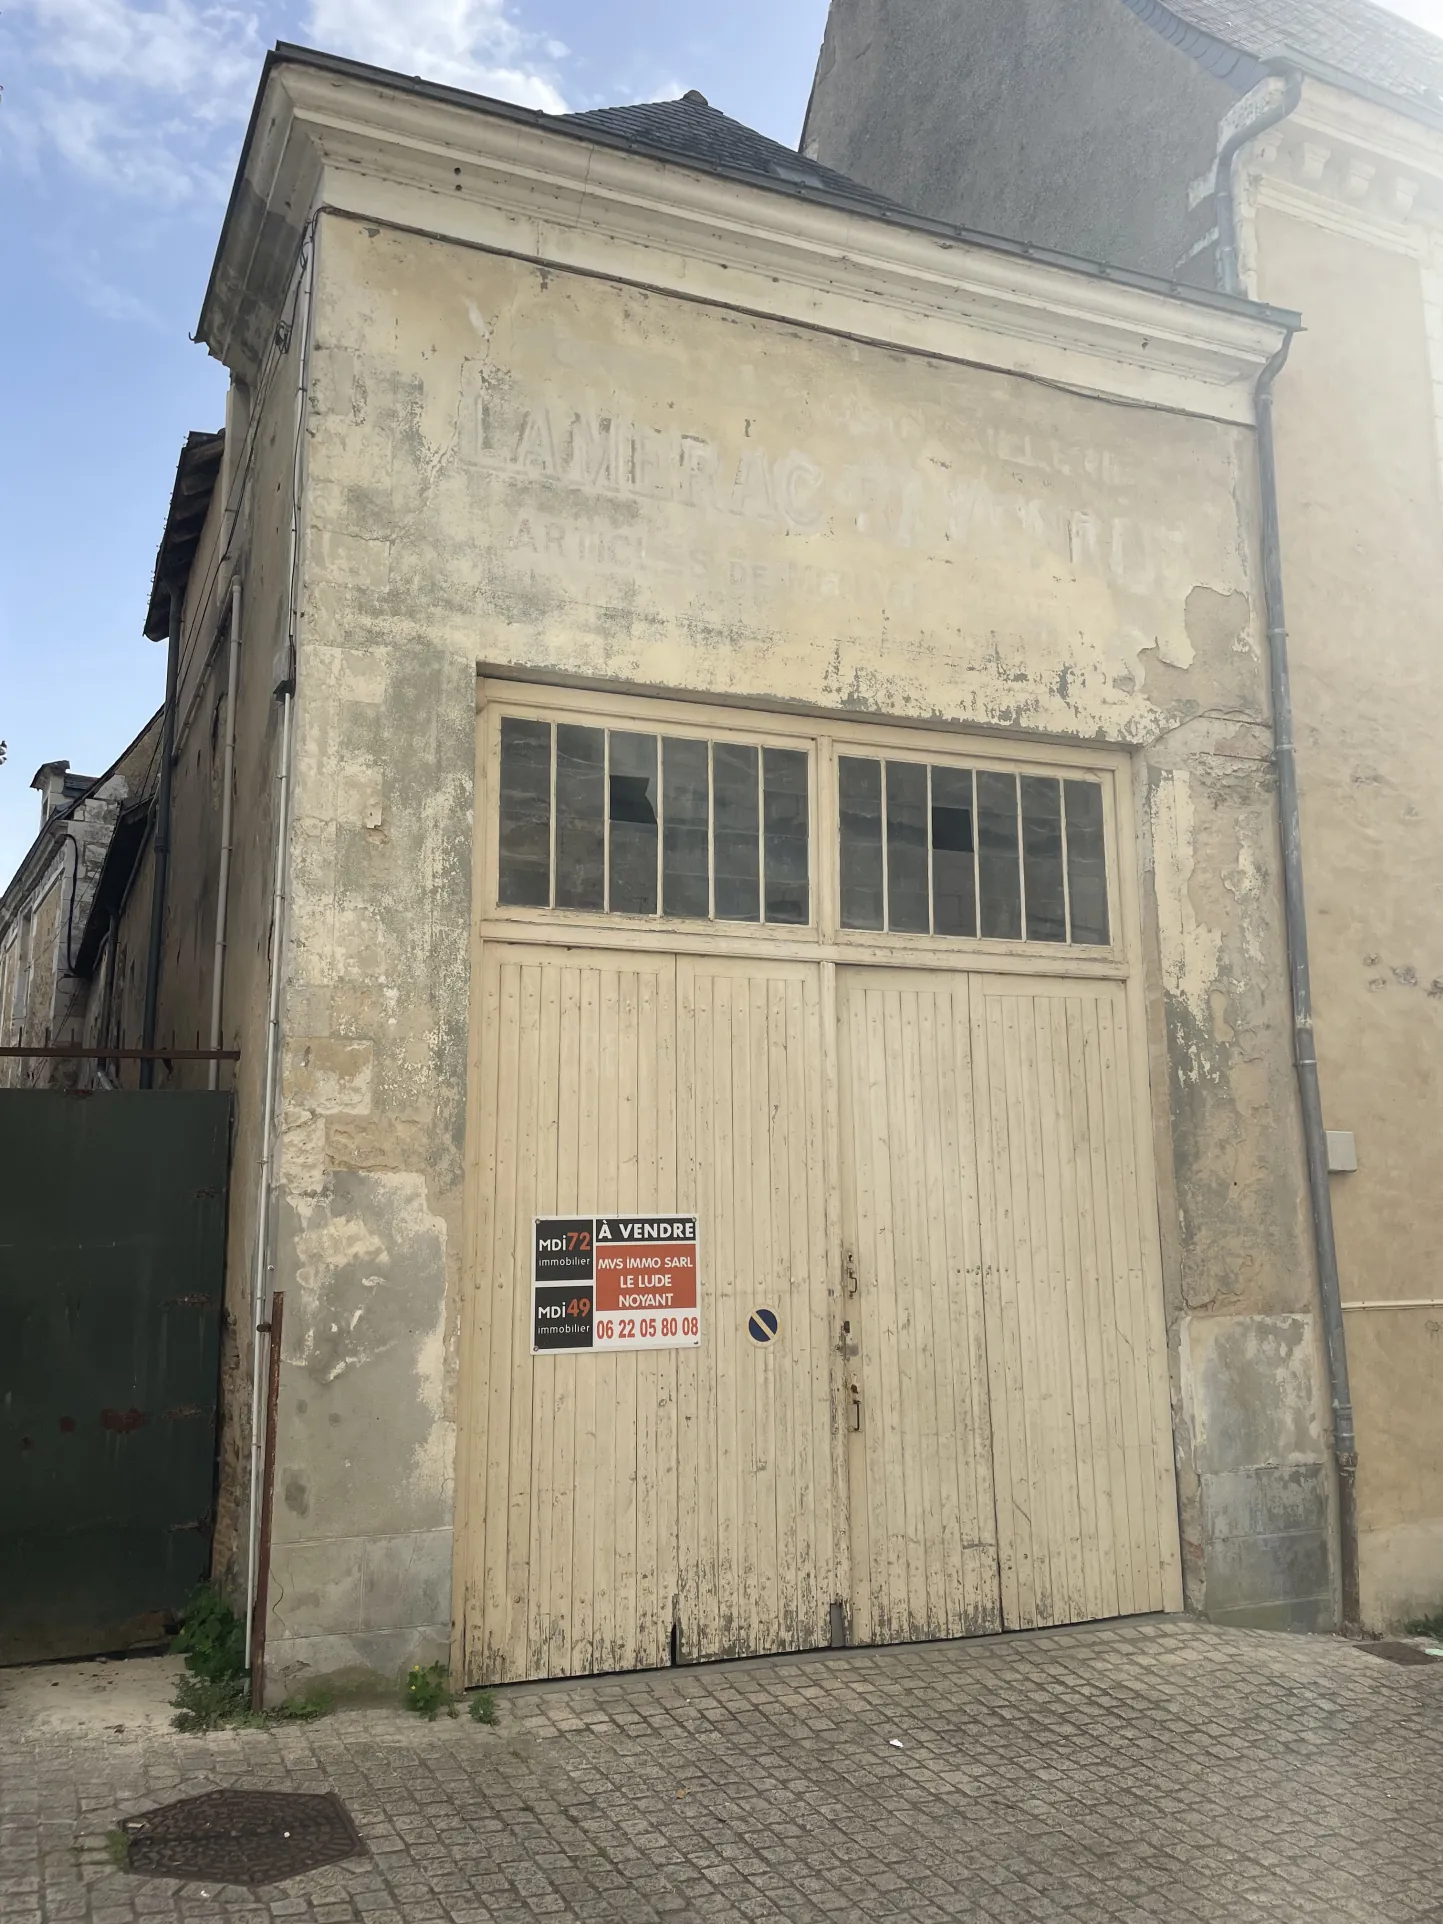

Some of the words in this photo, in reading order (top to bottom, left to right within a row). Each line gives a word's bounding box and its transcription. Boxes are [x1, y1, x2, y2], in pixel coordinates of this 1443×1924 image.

[598, 1220, 612, 1240] À
[619, 1222, 694, 1238] VENDRE
[538, 1256, 590, 1267] immobilier
[598, 1257, 623, 1270] MVS
[664, 1256, 693, 1268] SARL
[620, 1275, 634, 1289] LE
[638, 1274, 672, 1288] LUDE
[618, 1293, 673, 1307] NOYANT
[537, 1323, 590, 1334] immobilier
[596, 1320, 613, 1339] 06
[618, 1319, 635, 1338] 22
[639, 1319, 657, 1338] 05
[661, 1317, 678, 1336] 80
[682, 1316, 698, 1336] 08
